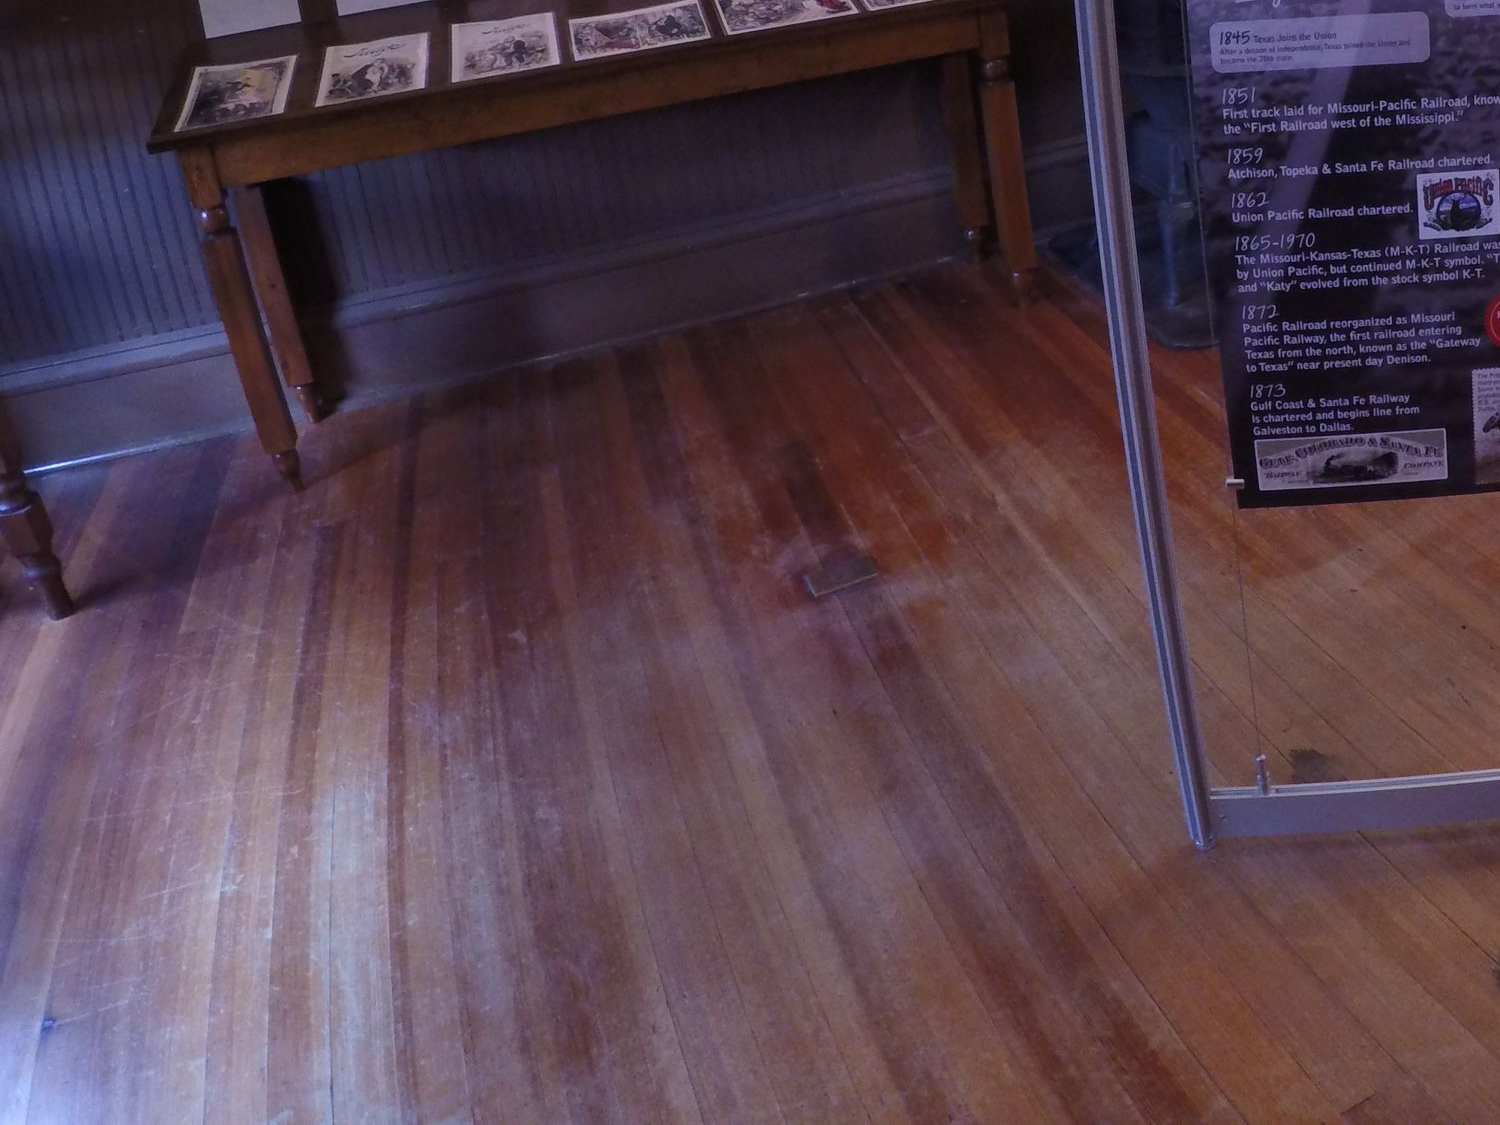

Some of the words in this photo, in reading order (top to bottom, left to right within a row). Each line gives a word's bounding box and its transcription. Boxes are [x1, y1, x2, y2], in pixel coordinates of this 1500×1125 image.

[1219, 29, 1251, 45] 1845
[1253, 34, 1275, 44] Texas
[1276, 33, 1298, 43] Joins
[1298, 32, 1312, 42] the
[1314, 31, 1337, 40] Union
[1222, 86, 1257, 105] 1851
[1222, 108, 1248, 120] First
[1252, 107, 1280, 119] track
[1283, 105, 1304, 116] laid
[1306, 103, 1324, 115] for
[1326, 98, 1417, 114] Missouri-Pacific
[1420, 96, 1471, 111] Railroad,
[1223, 123, 1241, 135] the
[1243, 121, 1278, 134] “First
[1280, 118, 1328, 131] Railroad
[1331, 118, 1357, 129] west
[1358, 115, 1371, 128] of
[1373, 114, 1392, 127] the
[1395, 108, 1464, 125] Mississippi.”
[1227, 146, 1263, 165] 1859
[1228, 167, 1278, 180] Atchison,
[1280, 165, 1318, 178] Topeka
[1321, 162, 1332, 174] &
[1334, 162, 1368, 174] Santa
[1370, 159, 1384, 171] Fe
[1388, 157, 1435, 170] Railroad
[1437, 155, 1494, 167] chartered.
[1231, 191, 1269, 209] 1862
[1231, 211, 1264, 223] Union
[1266, 207, 1305, 221] Pacific
[1307, 205, 1355, 219] Railroad
[1356, 202, 1414, 216] chartered.
[1235, 231, 1316, 252] 1865-1970
[1241, 303, 1280, 320] 1872
[1249, 382, 1286, 399] 1873
[1252, 425, 1303, 436] Galveston
[1304, 424, 1317, 433] to
[1319, 421, 1354, 432] Dallas.
